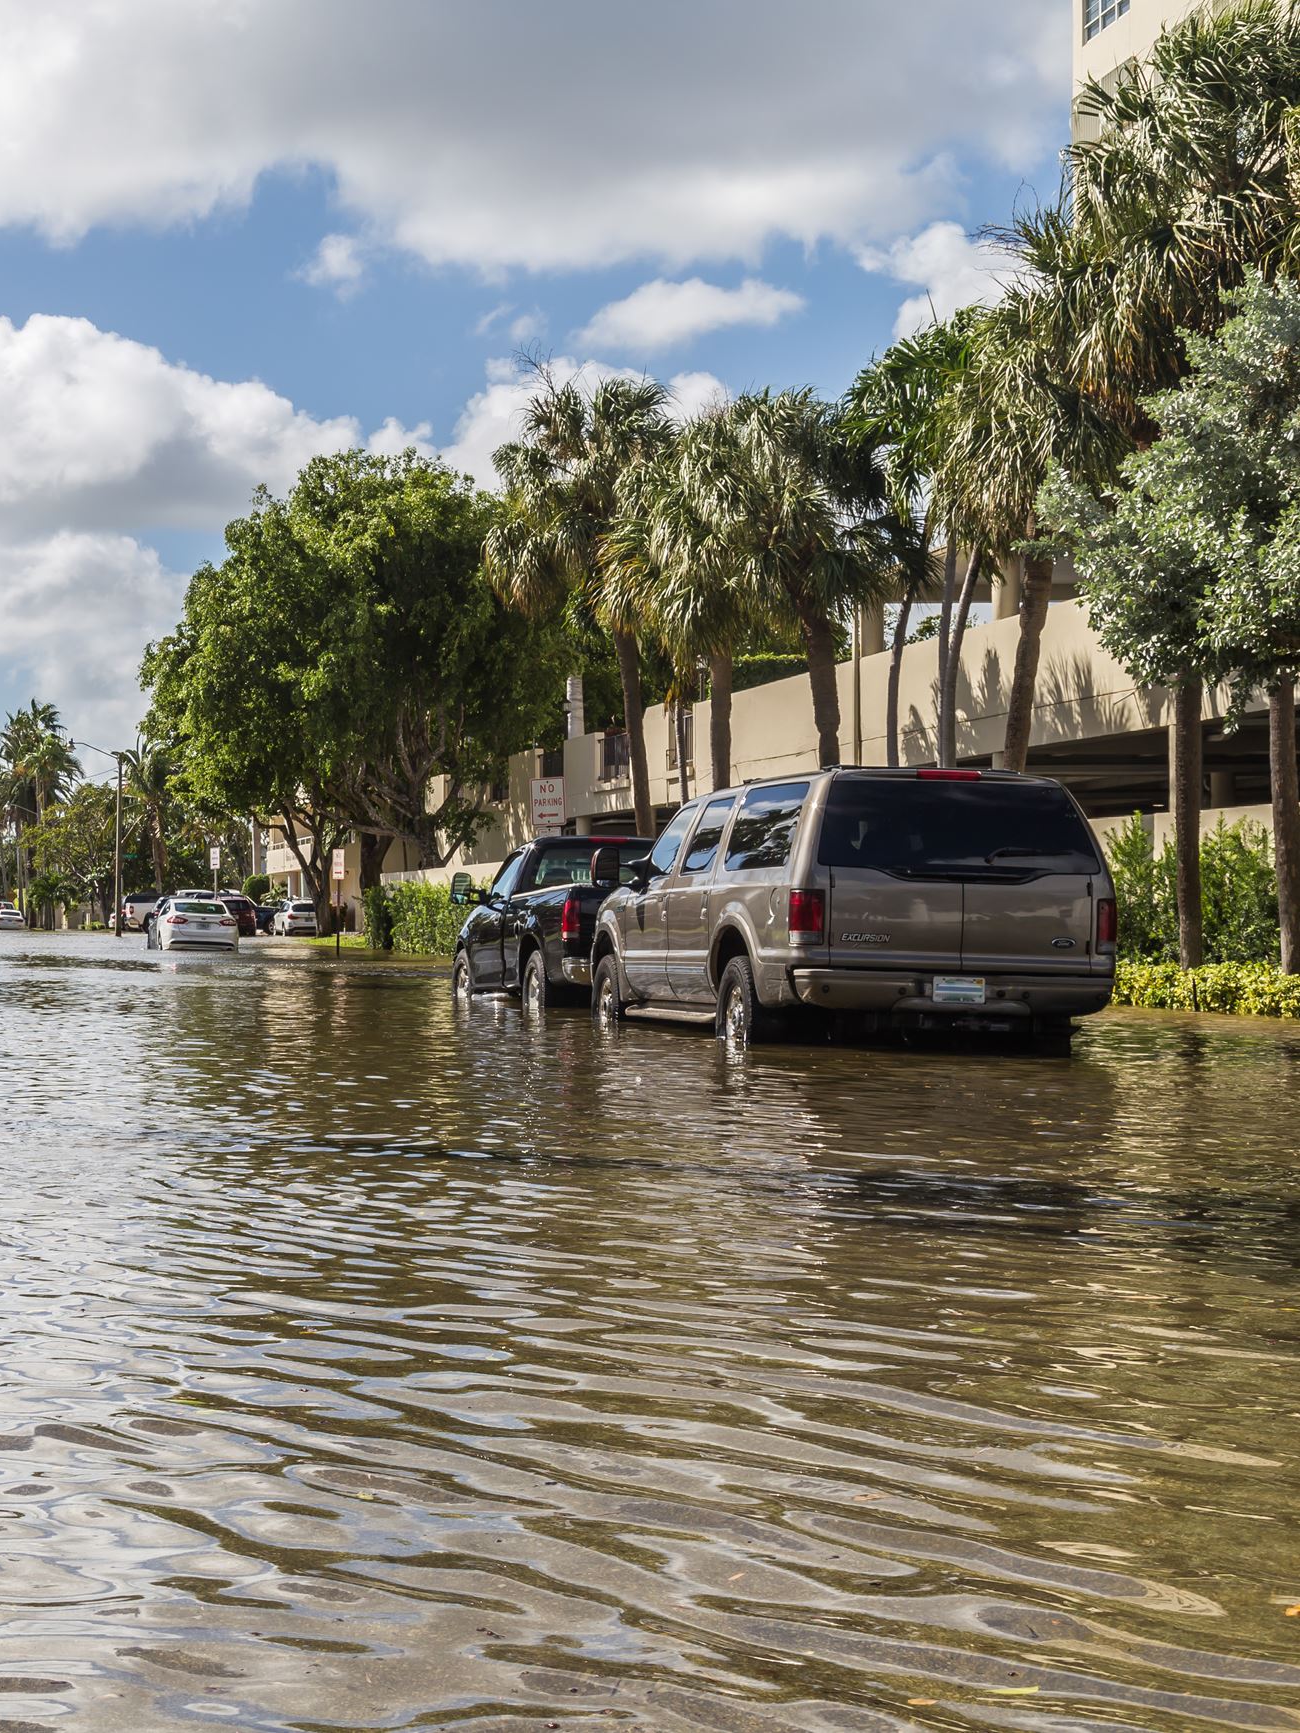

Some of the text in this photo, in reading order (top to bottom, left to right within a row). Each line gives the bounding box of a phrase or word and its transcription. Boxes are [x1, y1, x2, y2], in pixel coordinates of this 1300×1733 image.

[539, 783, 555, 794] NO
[533, 797, 563, 807] PARKING
[841, 933, 891, 942] EXCURSION
